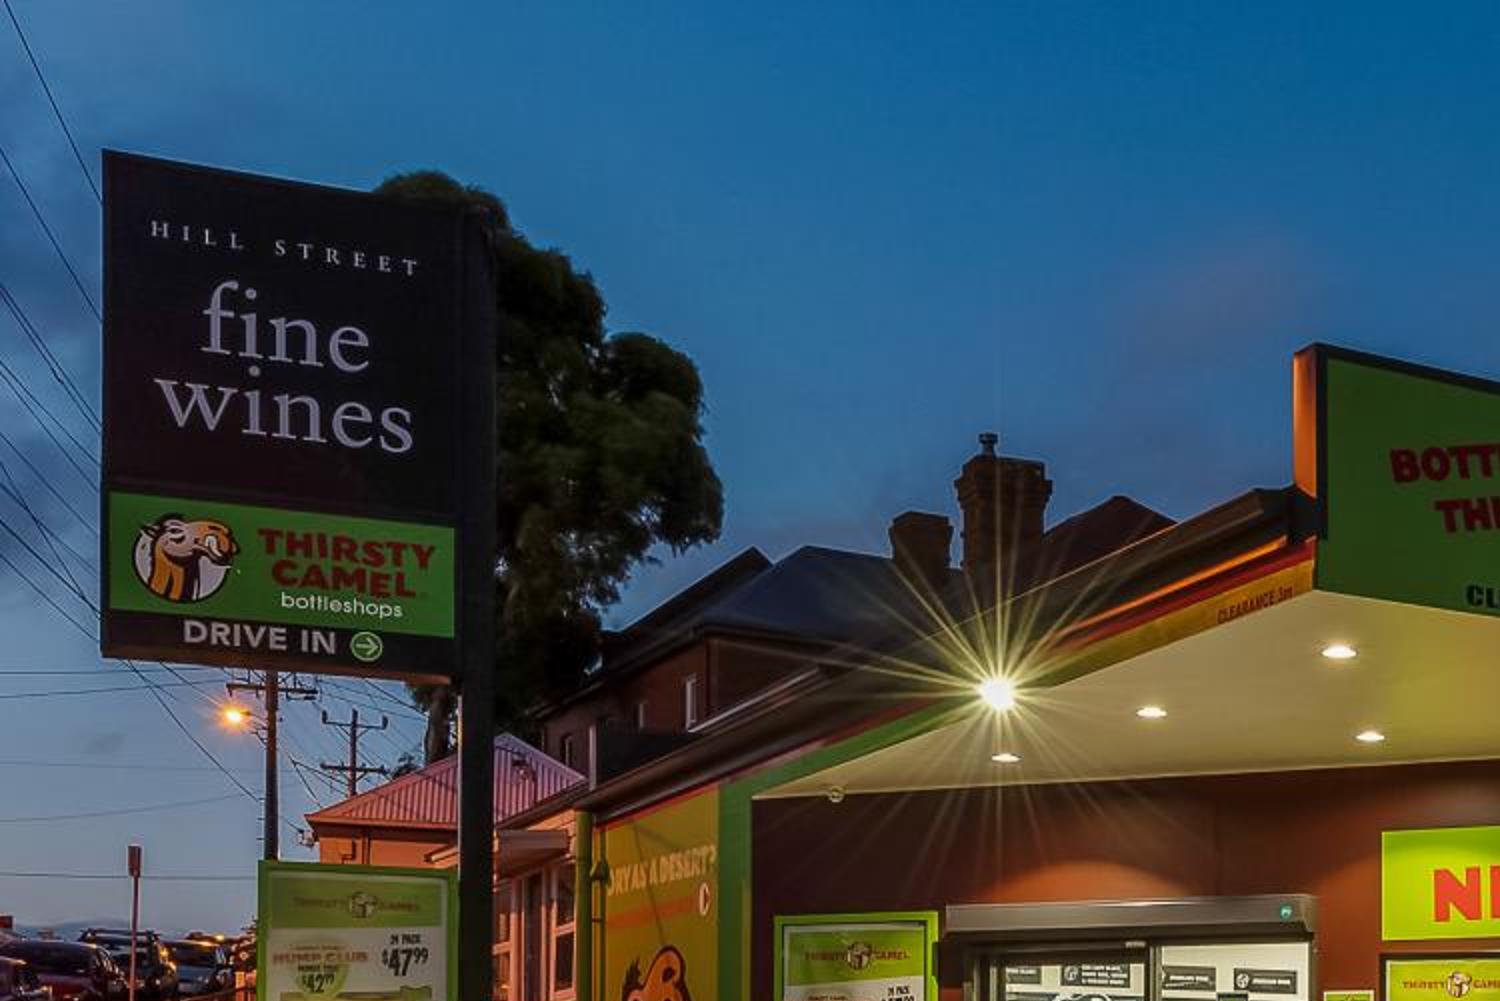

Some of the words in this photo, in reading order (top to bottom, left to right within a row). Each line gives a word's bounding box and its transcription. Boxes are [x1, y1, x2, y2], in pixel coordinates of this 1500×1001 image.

[151, 220, 243, 250] HILL
[274, 239, 418, 275] STREET
[201, 280, 369, 372] fine
[154, 365, 414, 453] wines
[258, 527, 436, 570] THIRSTY
[272, 560, 416, 598] CAMEL
[281, 592, 403, 620] bottleshops
[183, 620, 286, 651] DRIVE
[301, 628, 336, 655] IN
